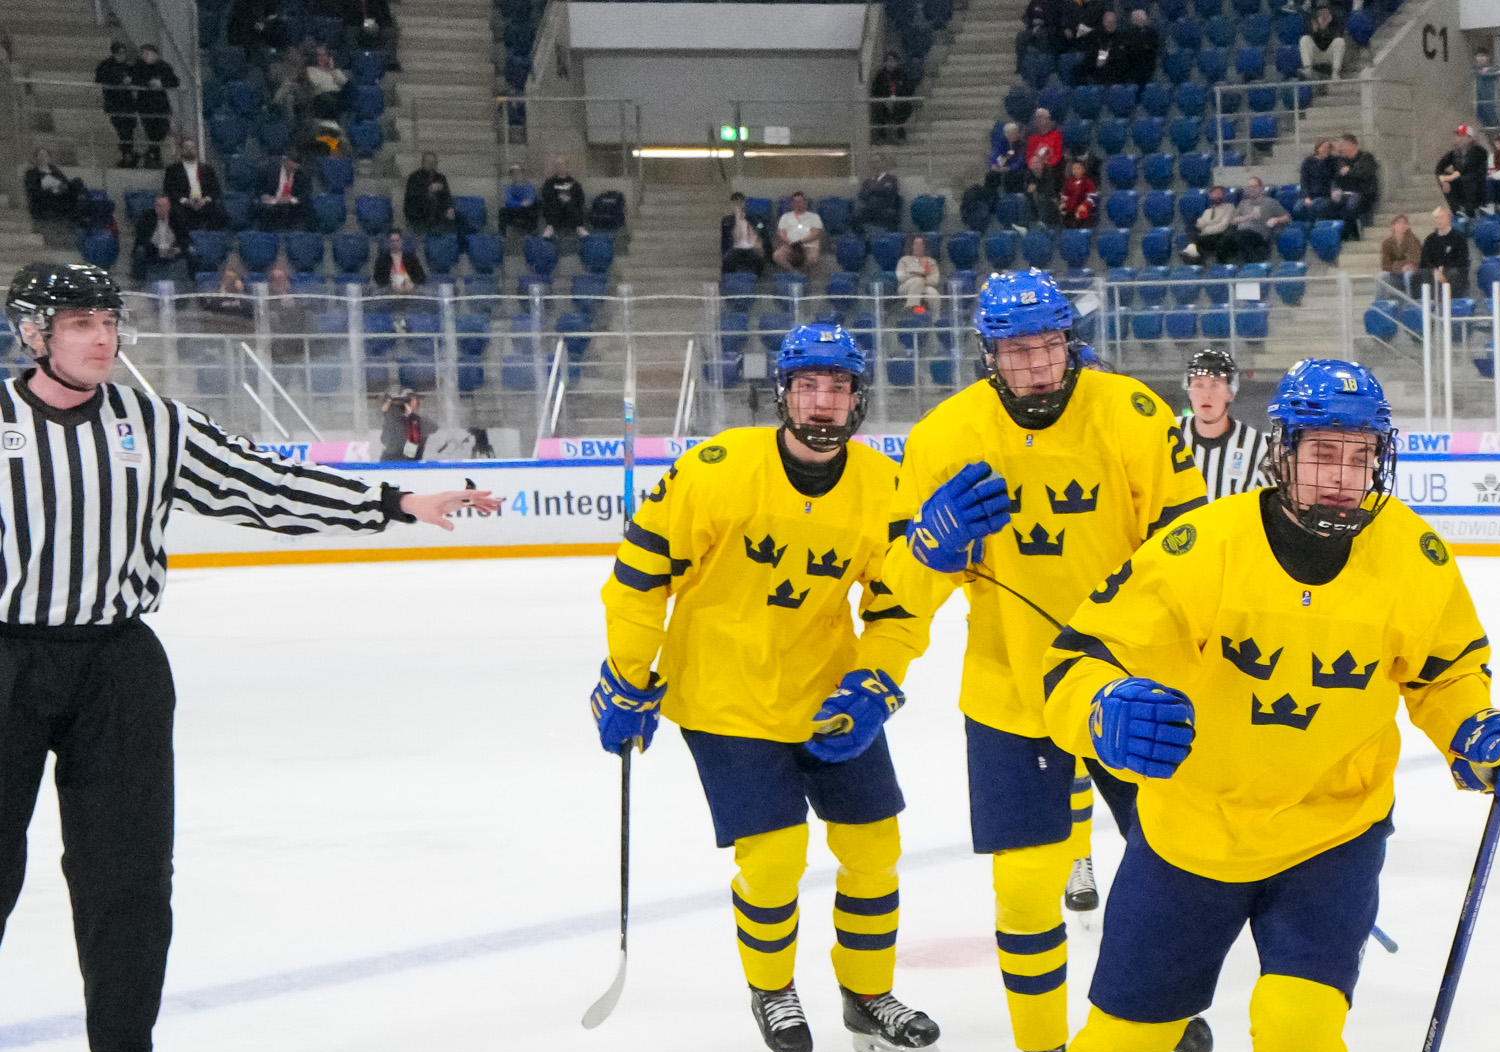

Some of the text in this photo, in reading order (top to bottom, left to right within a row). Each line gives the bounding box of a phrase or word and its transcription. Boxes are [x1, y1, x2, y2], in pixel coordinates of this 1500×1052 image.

[1422, 24, 1448, 62] C1
[1020, 291, 1037, 304] 22
[1341, 378, 1358, 392] 18
[1408, 434, 1451, 451] BWT
